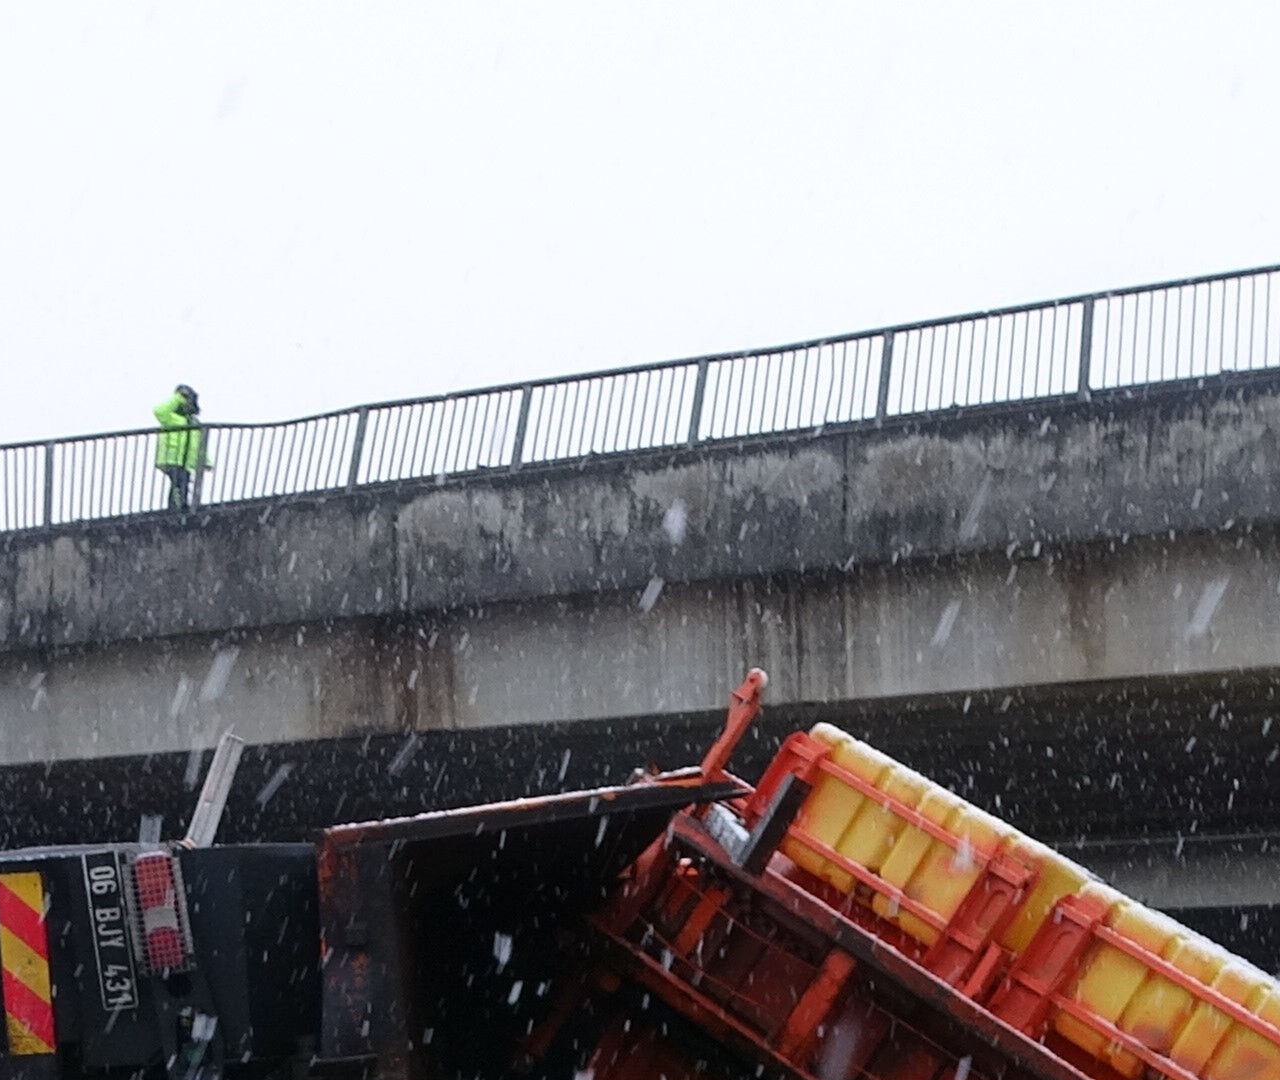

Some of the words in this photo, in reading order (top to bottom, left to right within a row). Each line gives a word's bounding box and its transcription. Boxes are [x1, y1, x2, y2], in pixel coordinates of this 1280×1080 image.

[90, 866, 117, 895] 06
[95, 908, 125, 948] BJY
[104, 965, 133, 1004] 431
